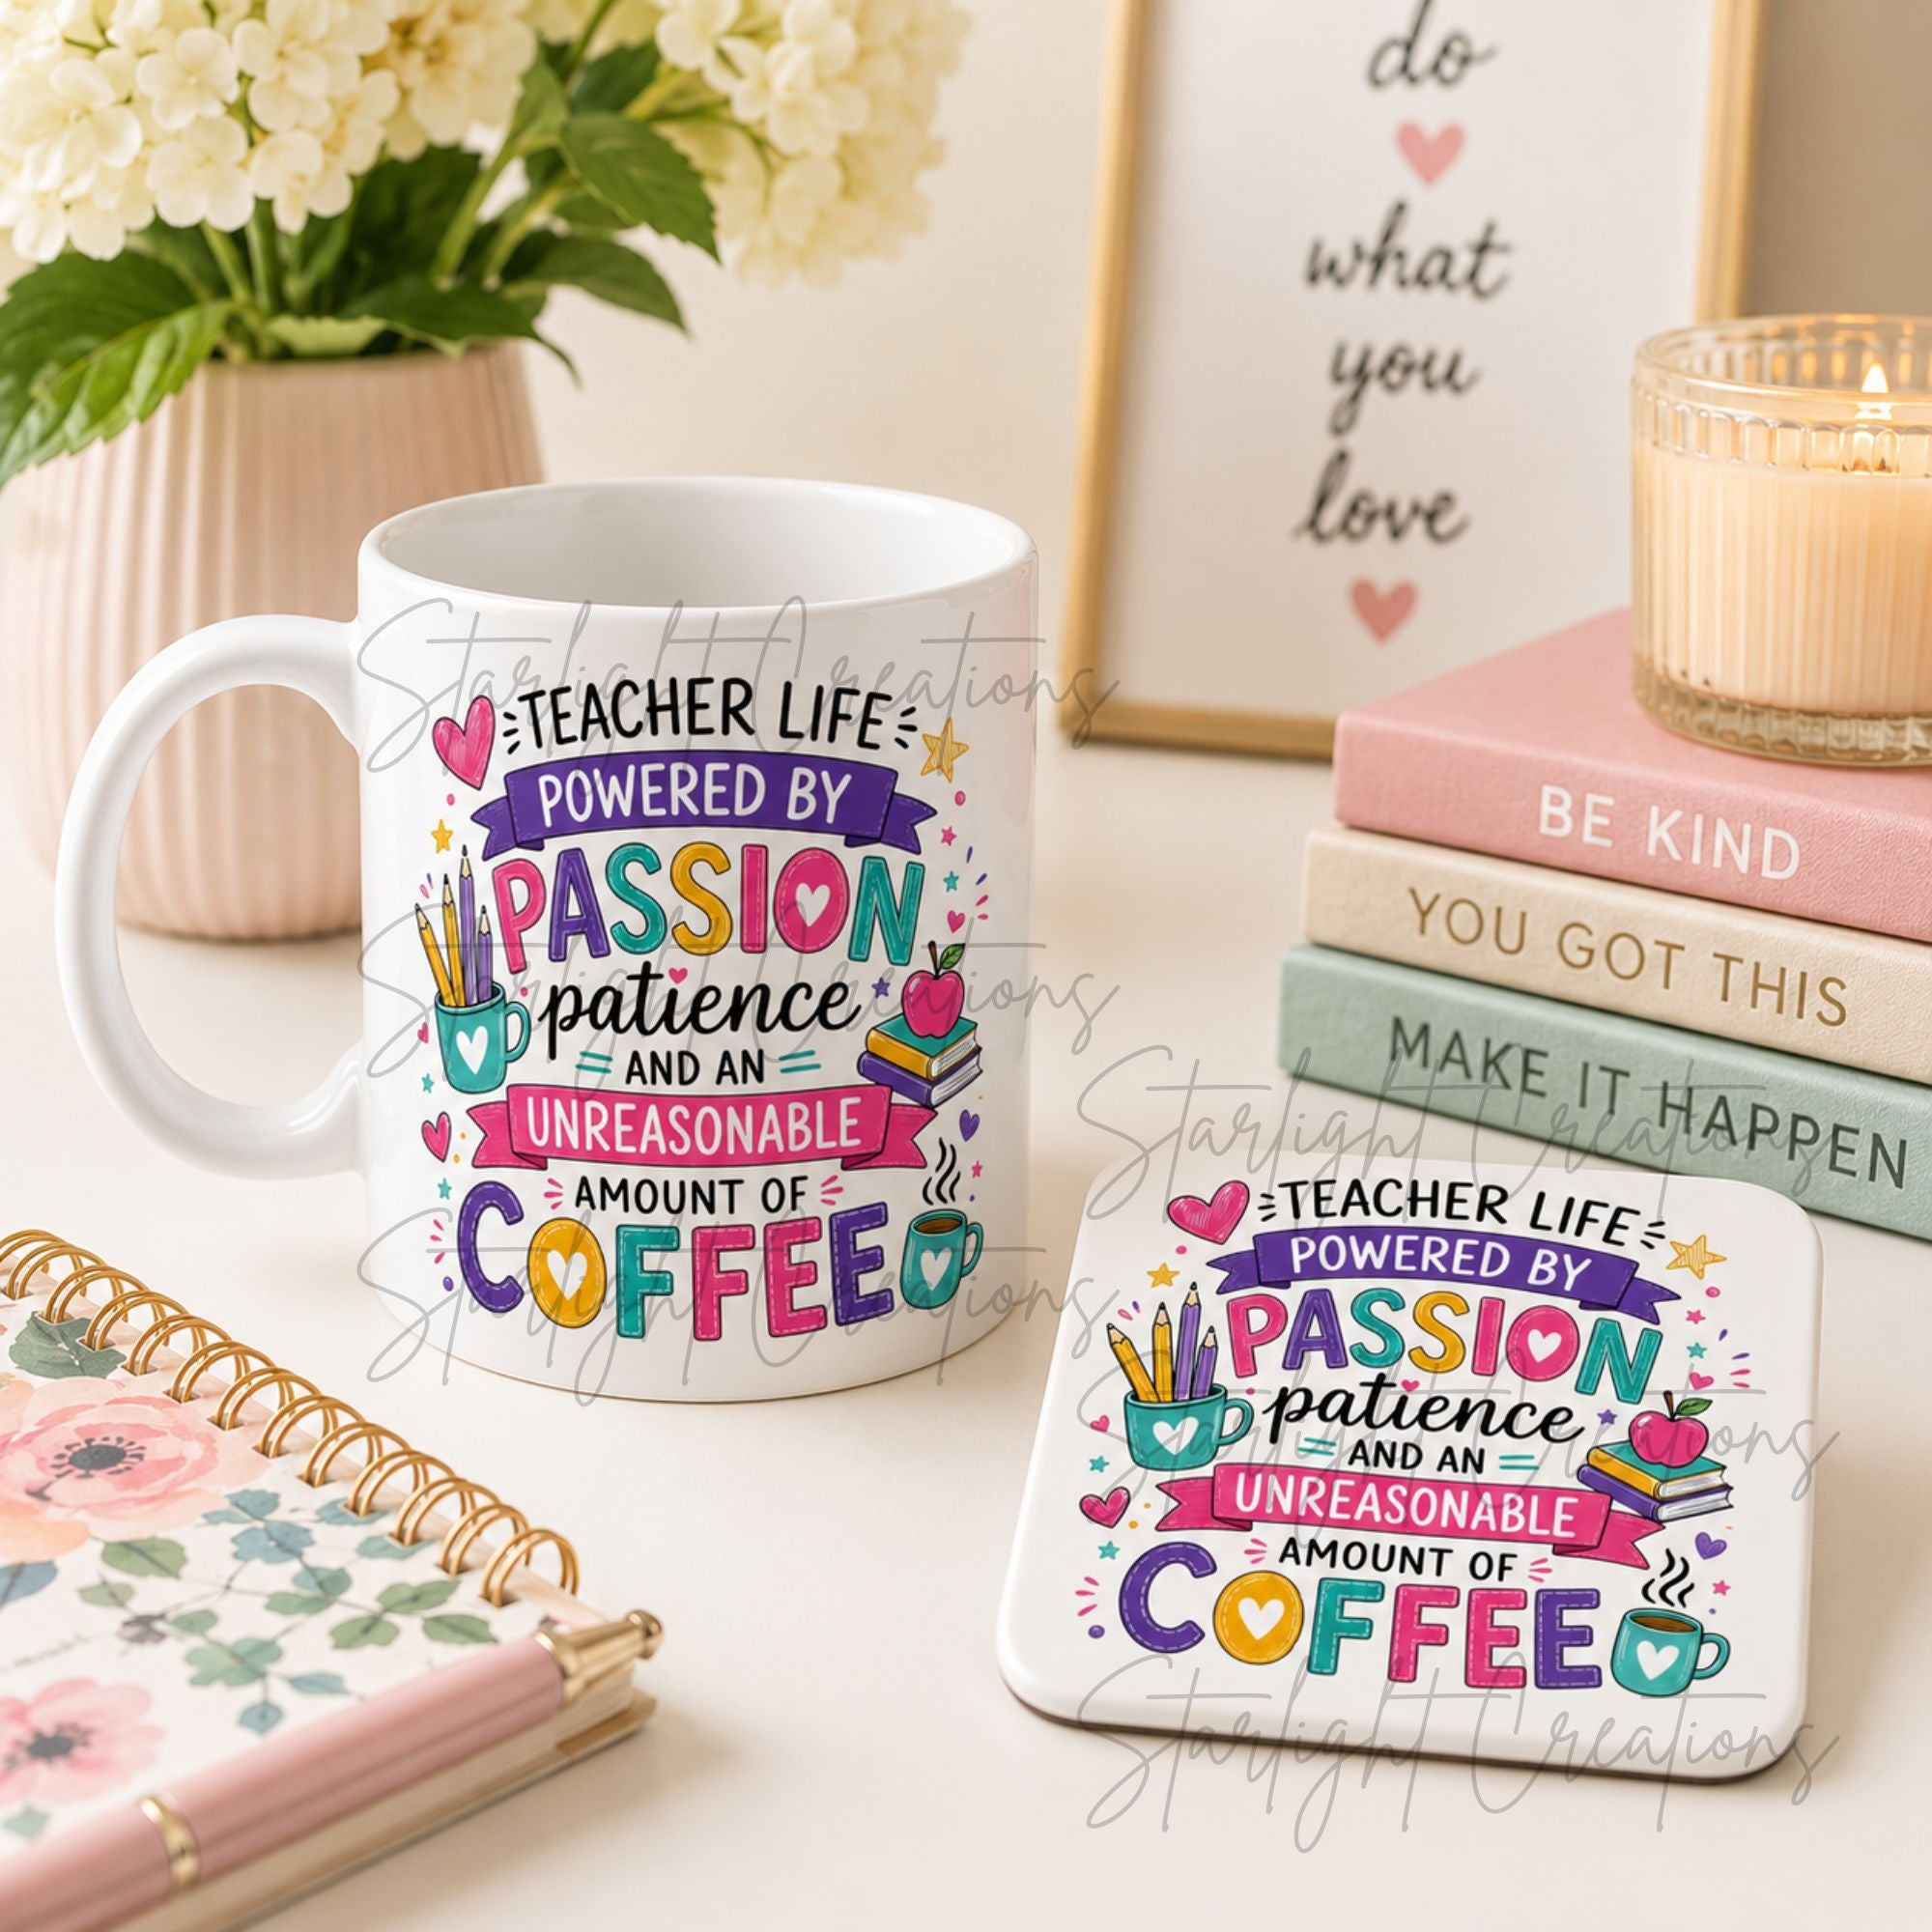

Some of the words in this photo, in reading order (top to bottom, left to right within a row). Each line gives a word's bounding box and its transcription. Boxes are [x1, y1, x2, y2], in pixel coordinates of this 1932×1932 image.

[1366, 0, 1497, 90] do
[1302, 198, 1513, 301] what
[1328, 339, 1481, 439] you
[1292, 448, 1469, 544] love
[518, 677, 755, 749] TEACHER
[781, 680, 894, 750] LIFE
[538, 762, 765, 827] POWERED
[785, 772, 853, 824] BY
[1539, 784, 1615, 847] BE
[1647, 806, 1800, 879] KIND
[491, 841, 925, 974] PASSION
[1407, 888, 1526, 954] YOU
[1558, 922, 1684, 989] GOT
[1713, 952, 1847, 1026] THIS
[538, 961, 862, 1060] patience
[625, 1051, 701, 1085] AND
[715, 1050, 765, 1083] AN
[1389, 1016, 1548, 1097] MAKE
[1578, 1062, 1630, 1115] IT
[1659, 1080, 1907, 1188] HAPPEN
[526, 1097, 861, 1154] UNREASONABLE
[576, 1178, 746, 1215] AMOUNT
[763, 1176, 810, 1211] OF
[1279, 1179, 1508, 1225] TEACHER
[1531, 1191, 1641, 1247] LIFE
[457, 1181, 894, 1341] COFFEE
[1290, 1236, 1508, 1278] POWERED
[1526, 1249, 1592, 1290] BY
[1227, 1288, 1662, 1404] PASSION
[1263, 1373, 1586, 1444] patience
[1348, 1441, 1423, 1471] AND
[1437, 1445, 1486, 1472] AN
[1236, 1478, 1577, 1538] UNREASONABLE
[1277, 1538, 1454, 1577] AMOUNT
[1469, 1552, 1518, 1581] OF
[1119, 1541, 1603, 1690] COFFEE
